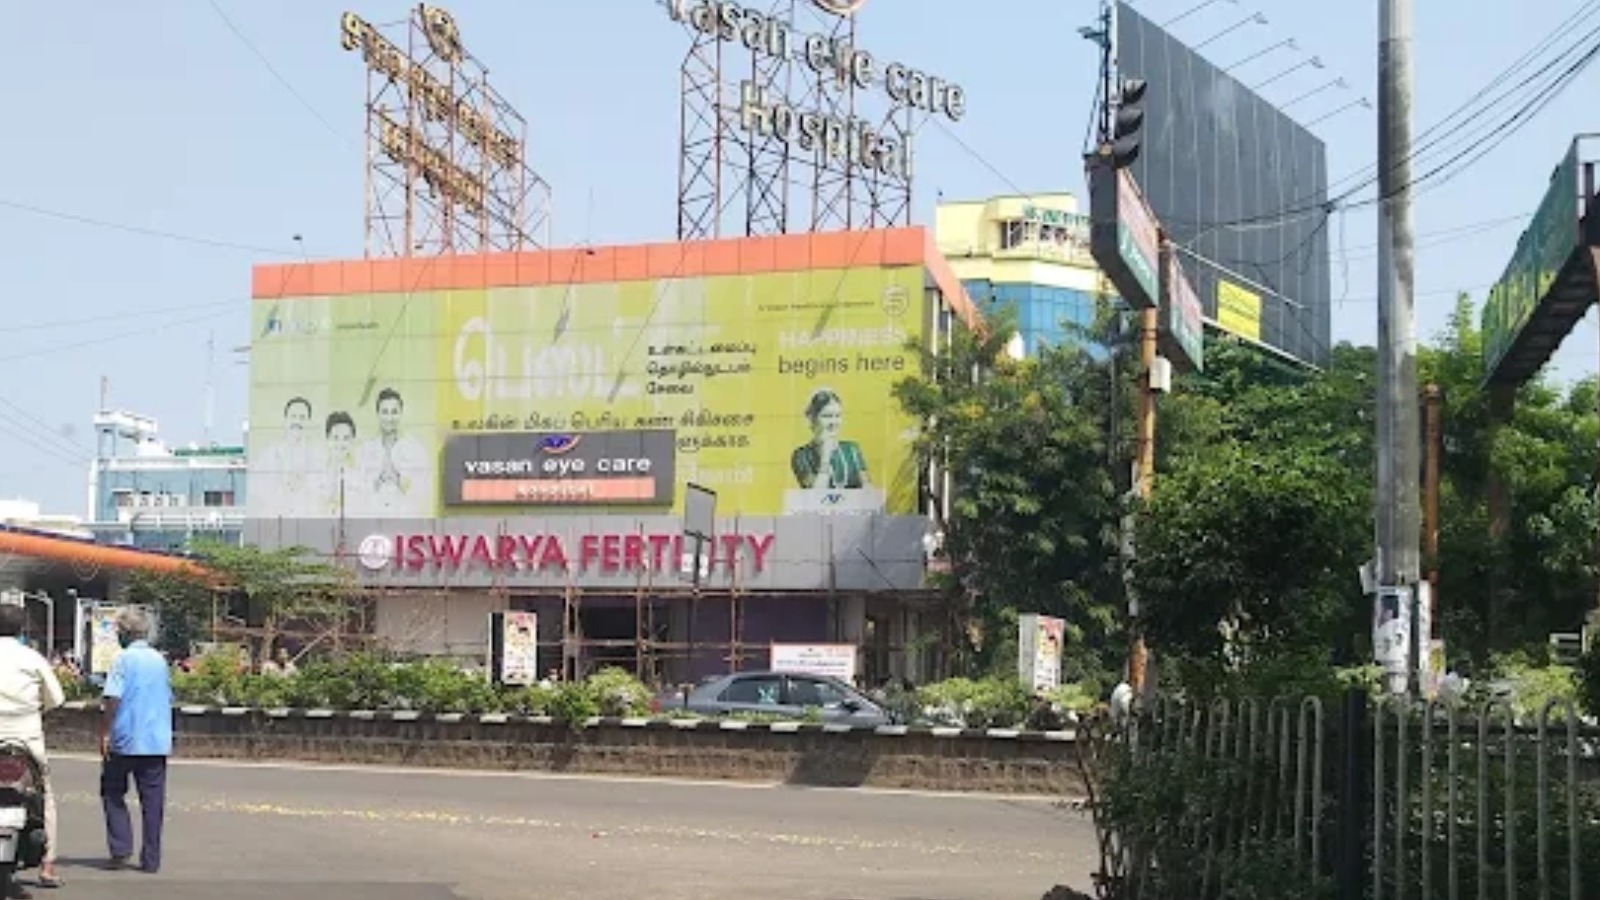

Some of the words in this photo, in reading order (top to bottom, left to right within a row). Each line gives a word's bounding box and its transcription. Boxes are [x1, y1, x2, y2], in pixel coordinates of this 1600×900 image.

[805, 34, 873, 91] eye
[885, 62, 964, 122] care
[741, 80, 913, 181] Hospital
[777, 354, 849, 379] begins
[855, 351, 905, 372] here
[464, 458, 532, 474] vasan
[542, 457, 586, 476] eye
[597, 456, 652, 473] care
[396, 534, 568, 571] ISWARYA
[581, 534, 775, 572] FERTIITY
